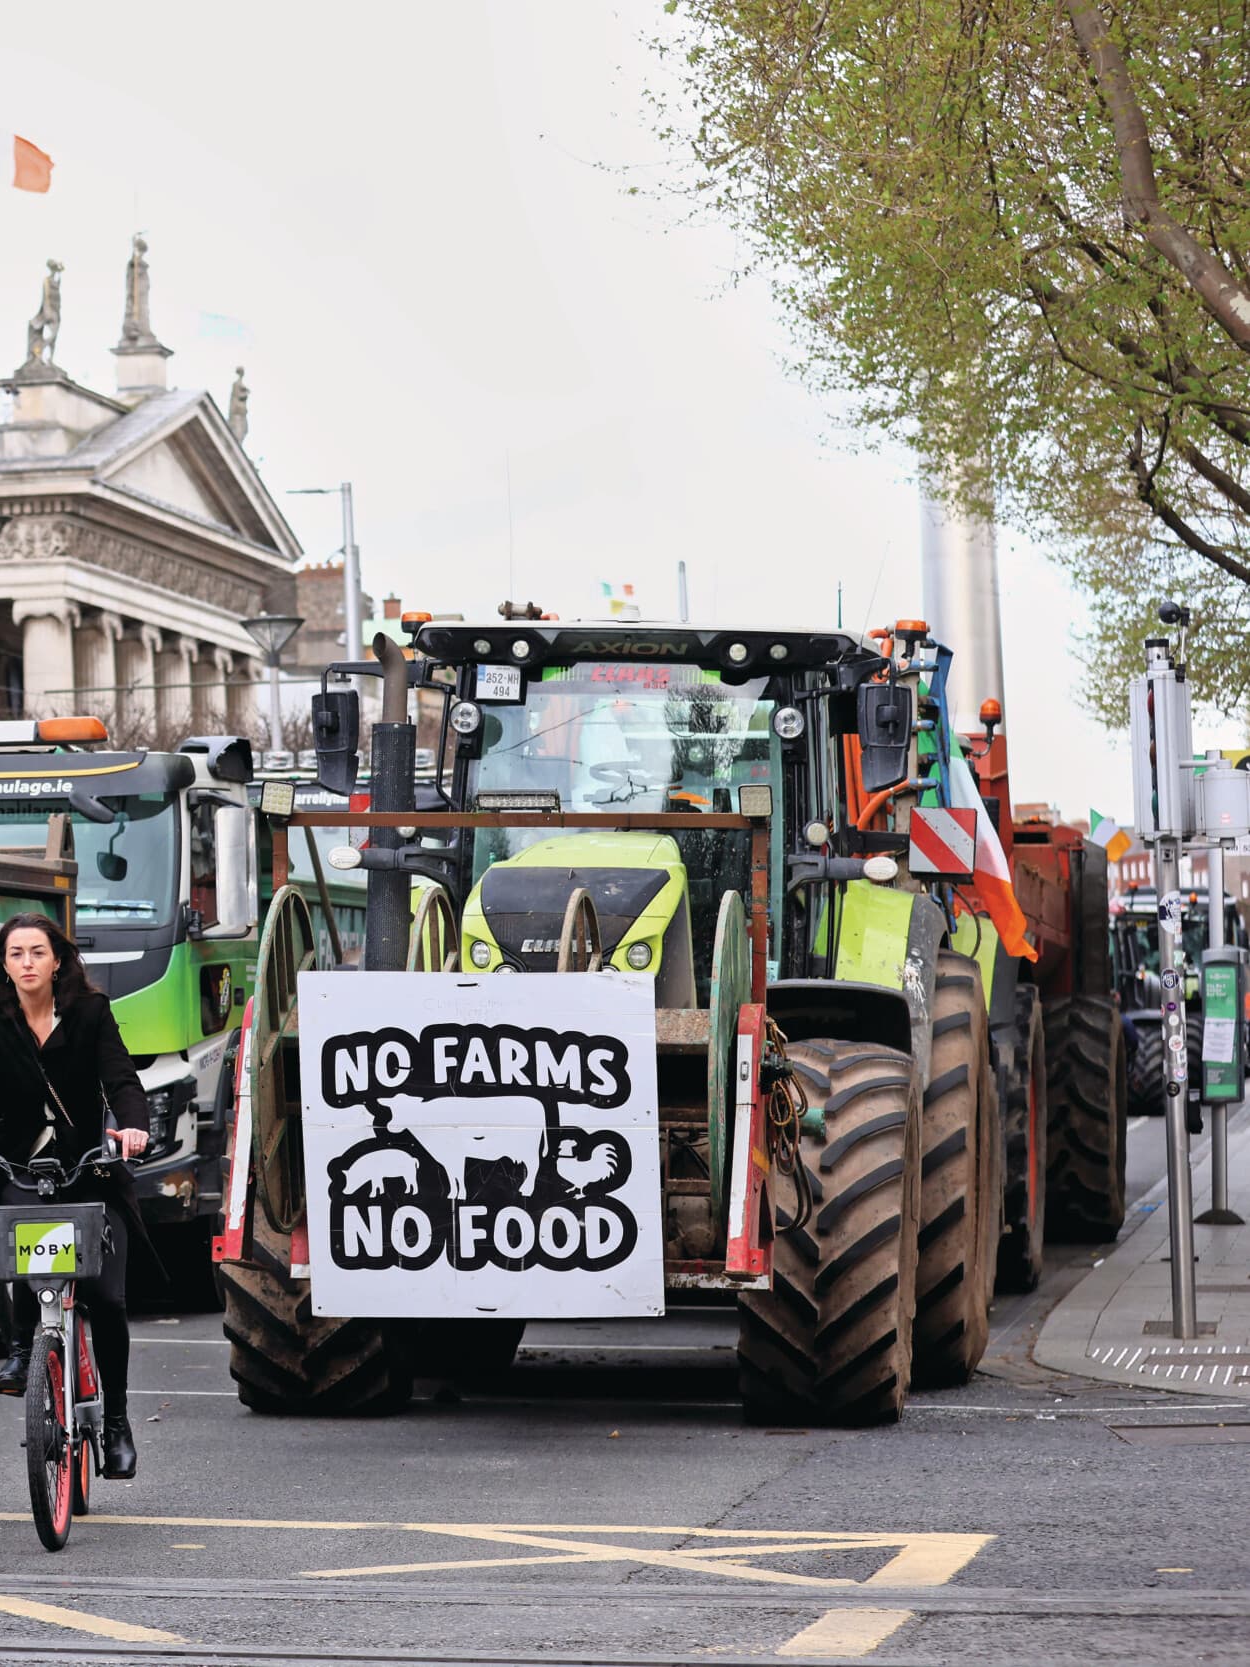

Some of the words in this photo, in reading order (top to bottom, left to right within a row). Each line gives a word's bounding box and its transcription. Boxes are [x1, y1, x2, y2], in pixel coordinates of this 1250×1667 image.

[573, 641, 688, 655] AXION
[591, 666, 671, 682] CLAAS
[493, 685, 510, 697] 494
[334, 1041, 412, 1095] NO
[433, 1036, 618, 1096] FARMS
[344, 1205, 432, 1258] NO
[459, 1205, 624, 1260] FOOD
[19, 1243, 72, 1256] MOBY
